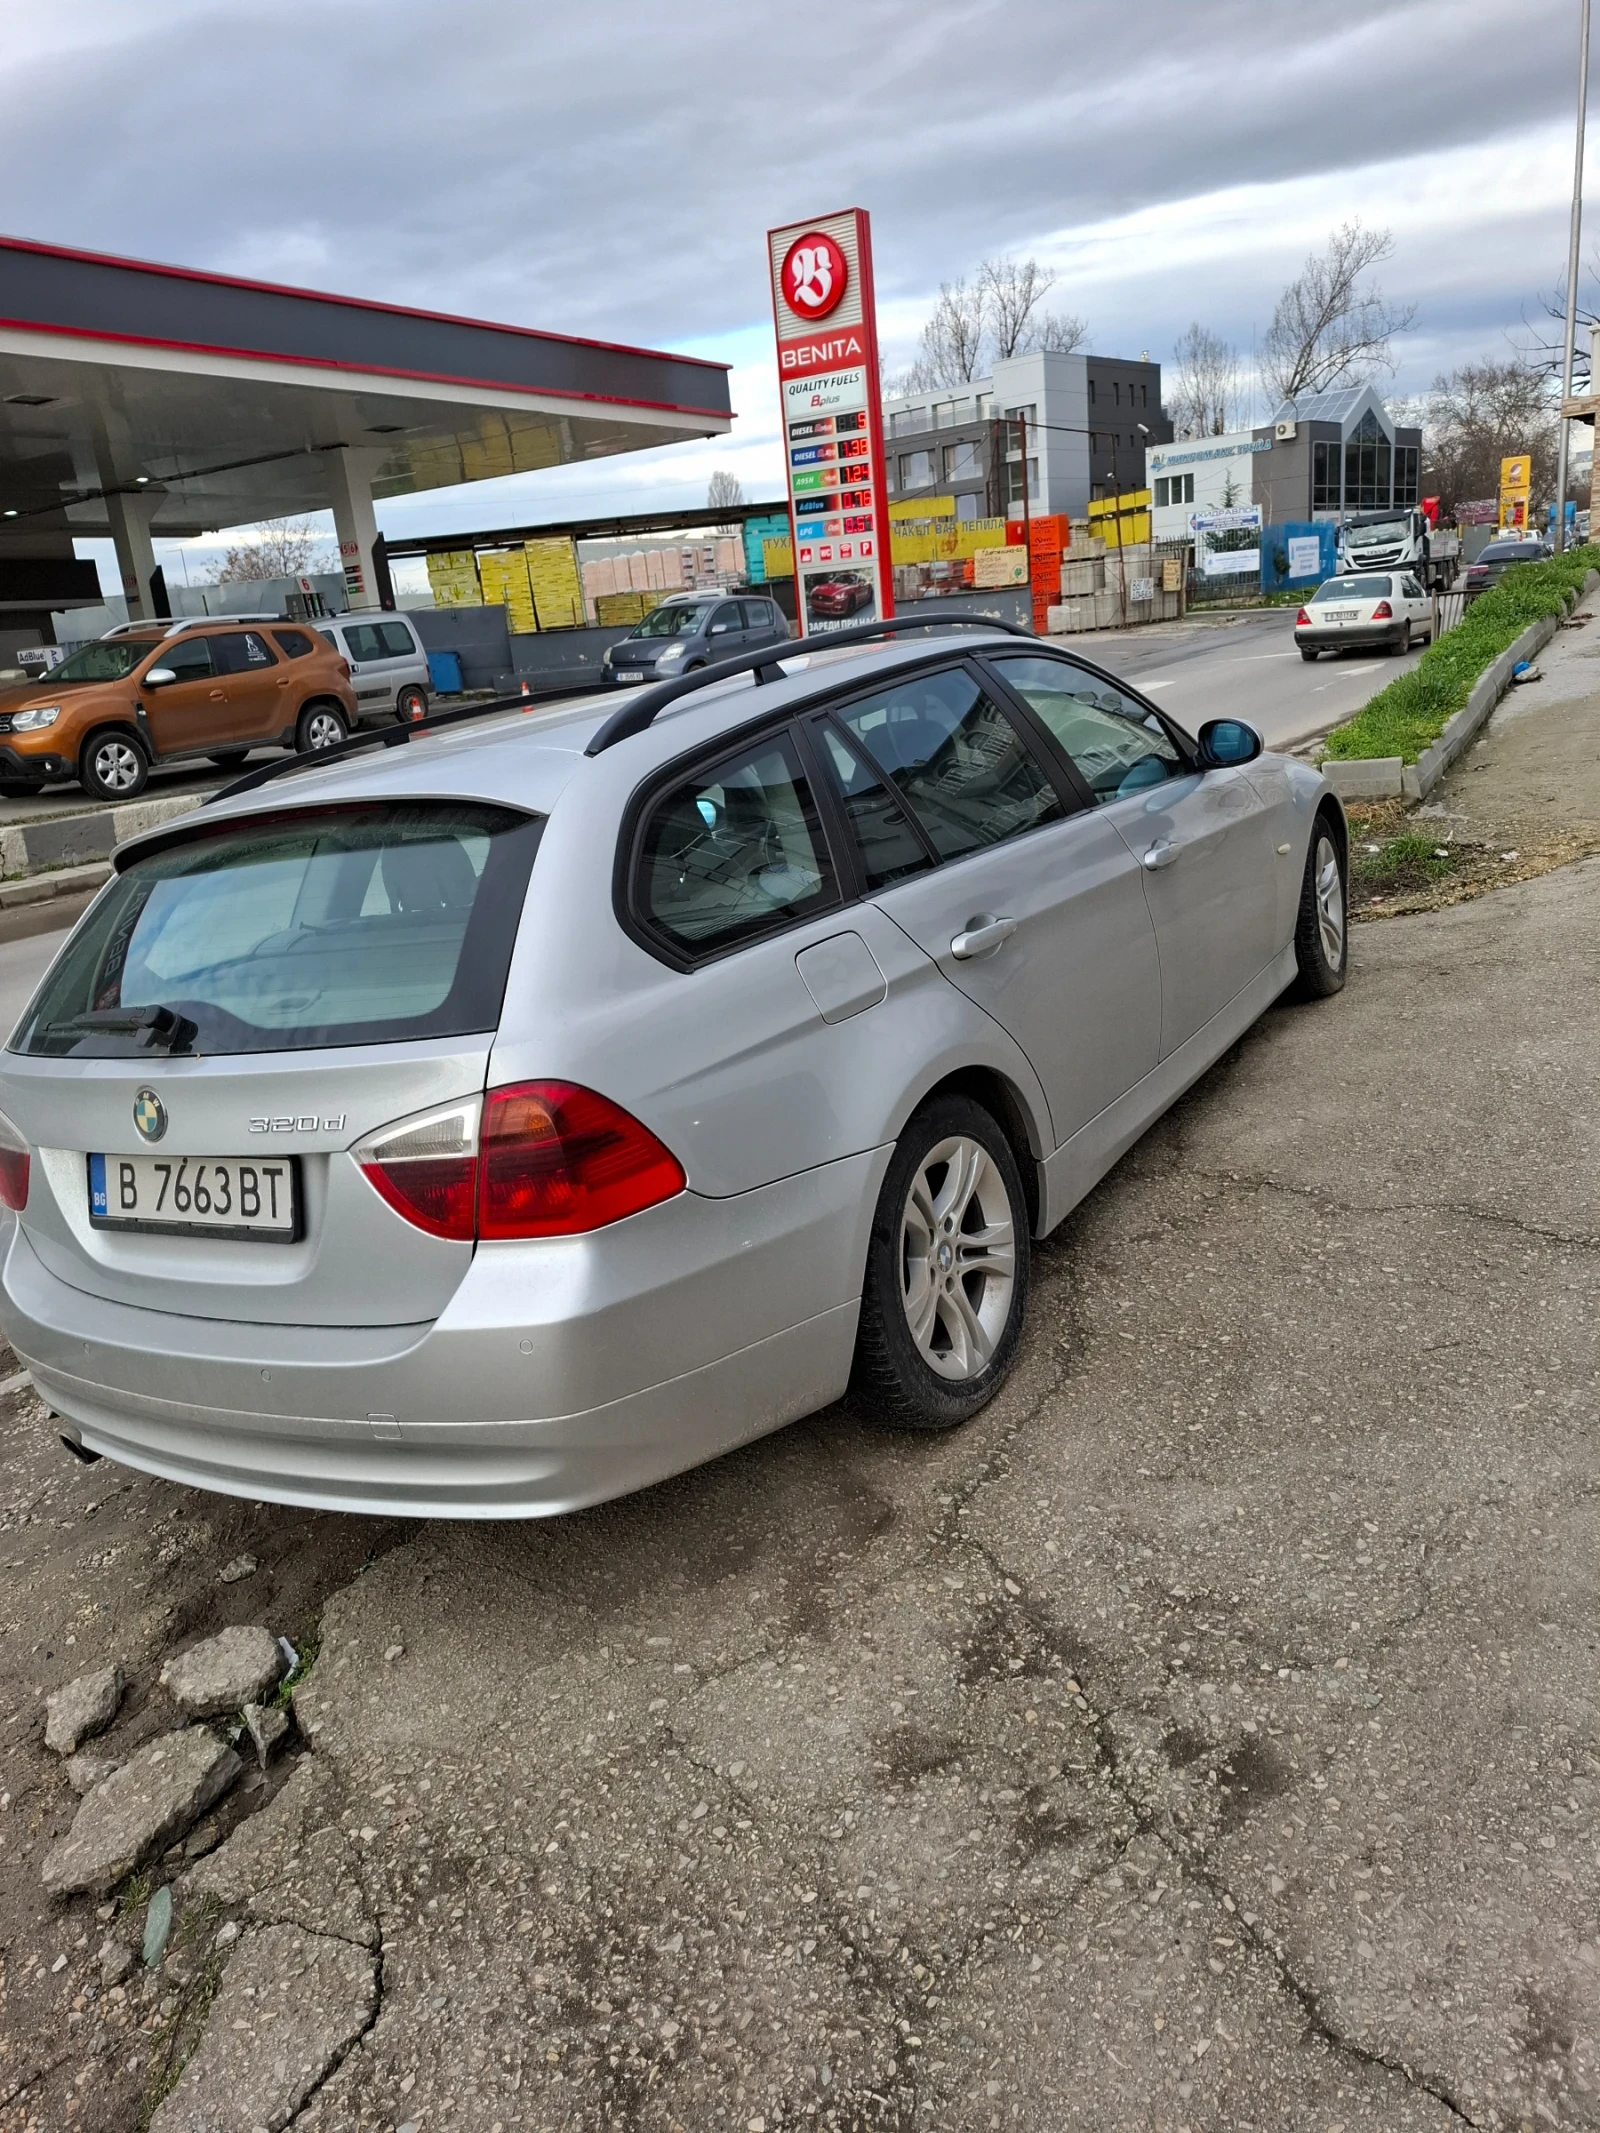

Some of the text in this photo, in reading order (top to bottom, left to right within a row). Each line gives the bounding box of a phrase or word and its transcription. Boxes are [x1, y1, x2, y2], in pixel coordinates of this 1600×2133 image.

[781, 337, 862, 369] BENITA
[788, 372, 860, 396] QUALITY FUELS
[792, 425, 814, 436] DIESEL
[843, 438, 869, 457] 1.38
[794, 451, 816, 461] DIESEL
[799, 501, 825, 511] AdBlue
[800, 527, 813, 536] LPG
[894, 525, 930, 538] ЧАКЪЛ
[961, 519, 1005, 532] ЛЕПИЛА
[301, 578, 310, 591] 6
[809, 620, 840, 632] ЗАРЕДИ
[841, 617, 859, 629] ПРИ
[19, 650, 44, 662] AdBlue
[248, 1113, 346, 1133] 320d
[119, 1162, 284, 1219] B 7663 BT
[94, 1192, 106, 1206] BG
